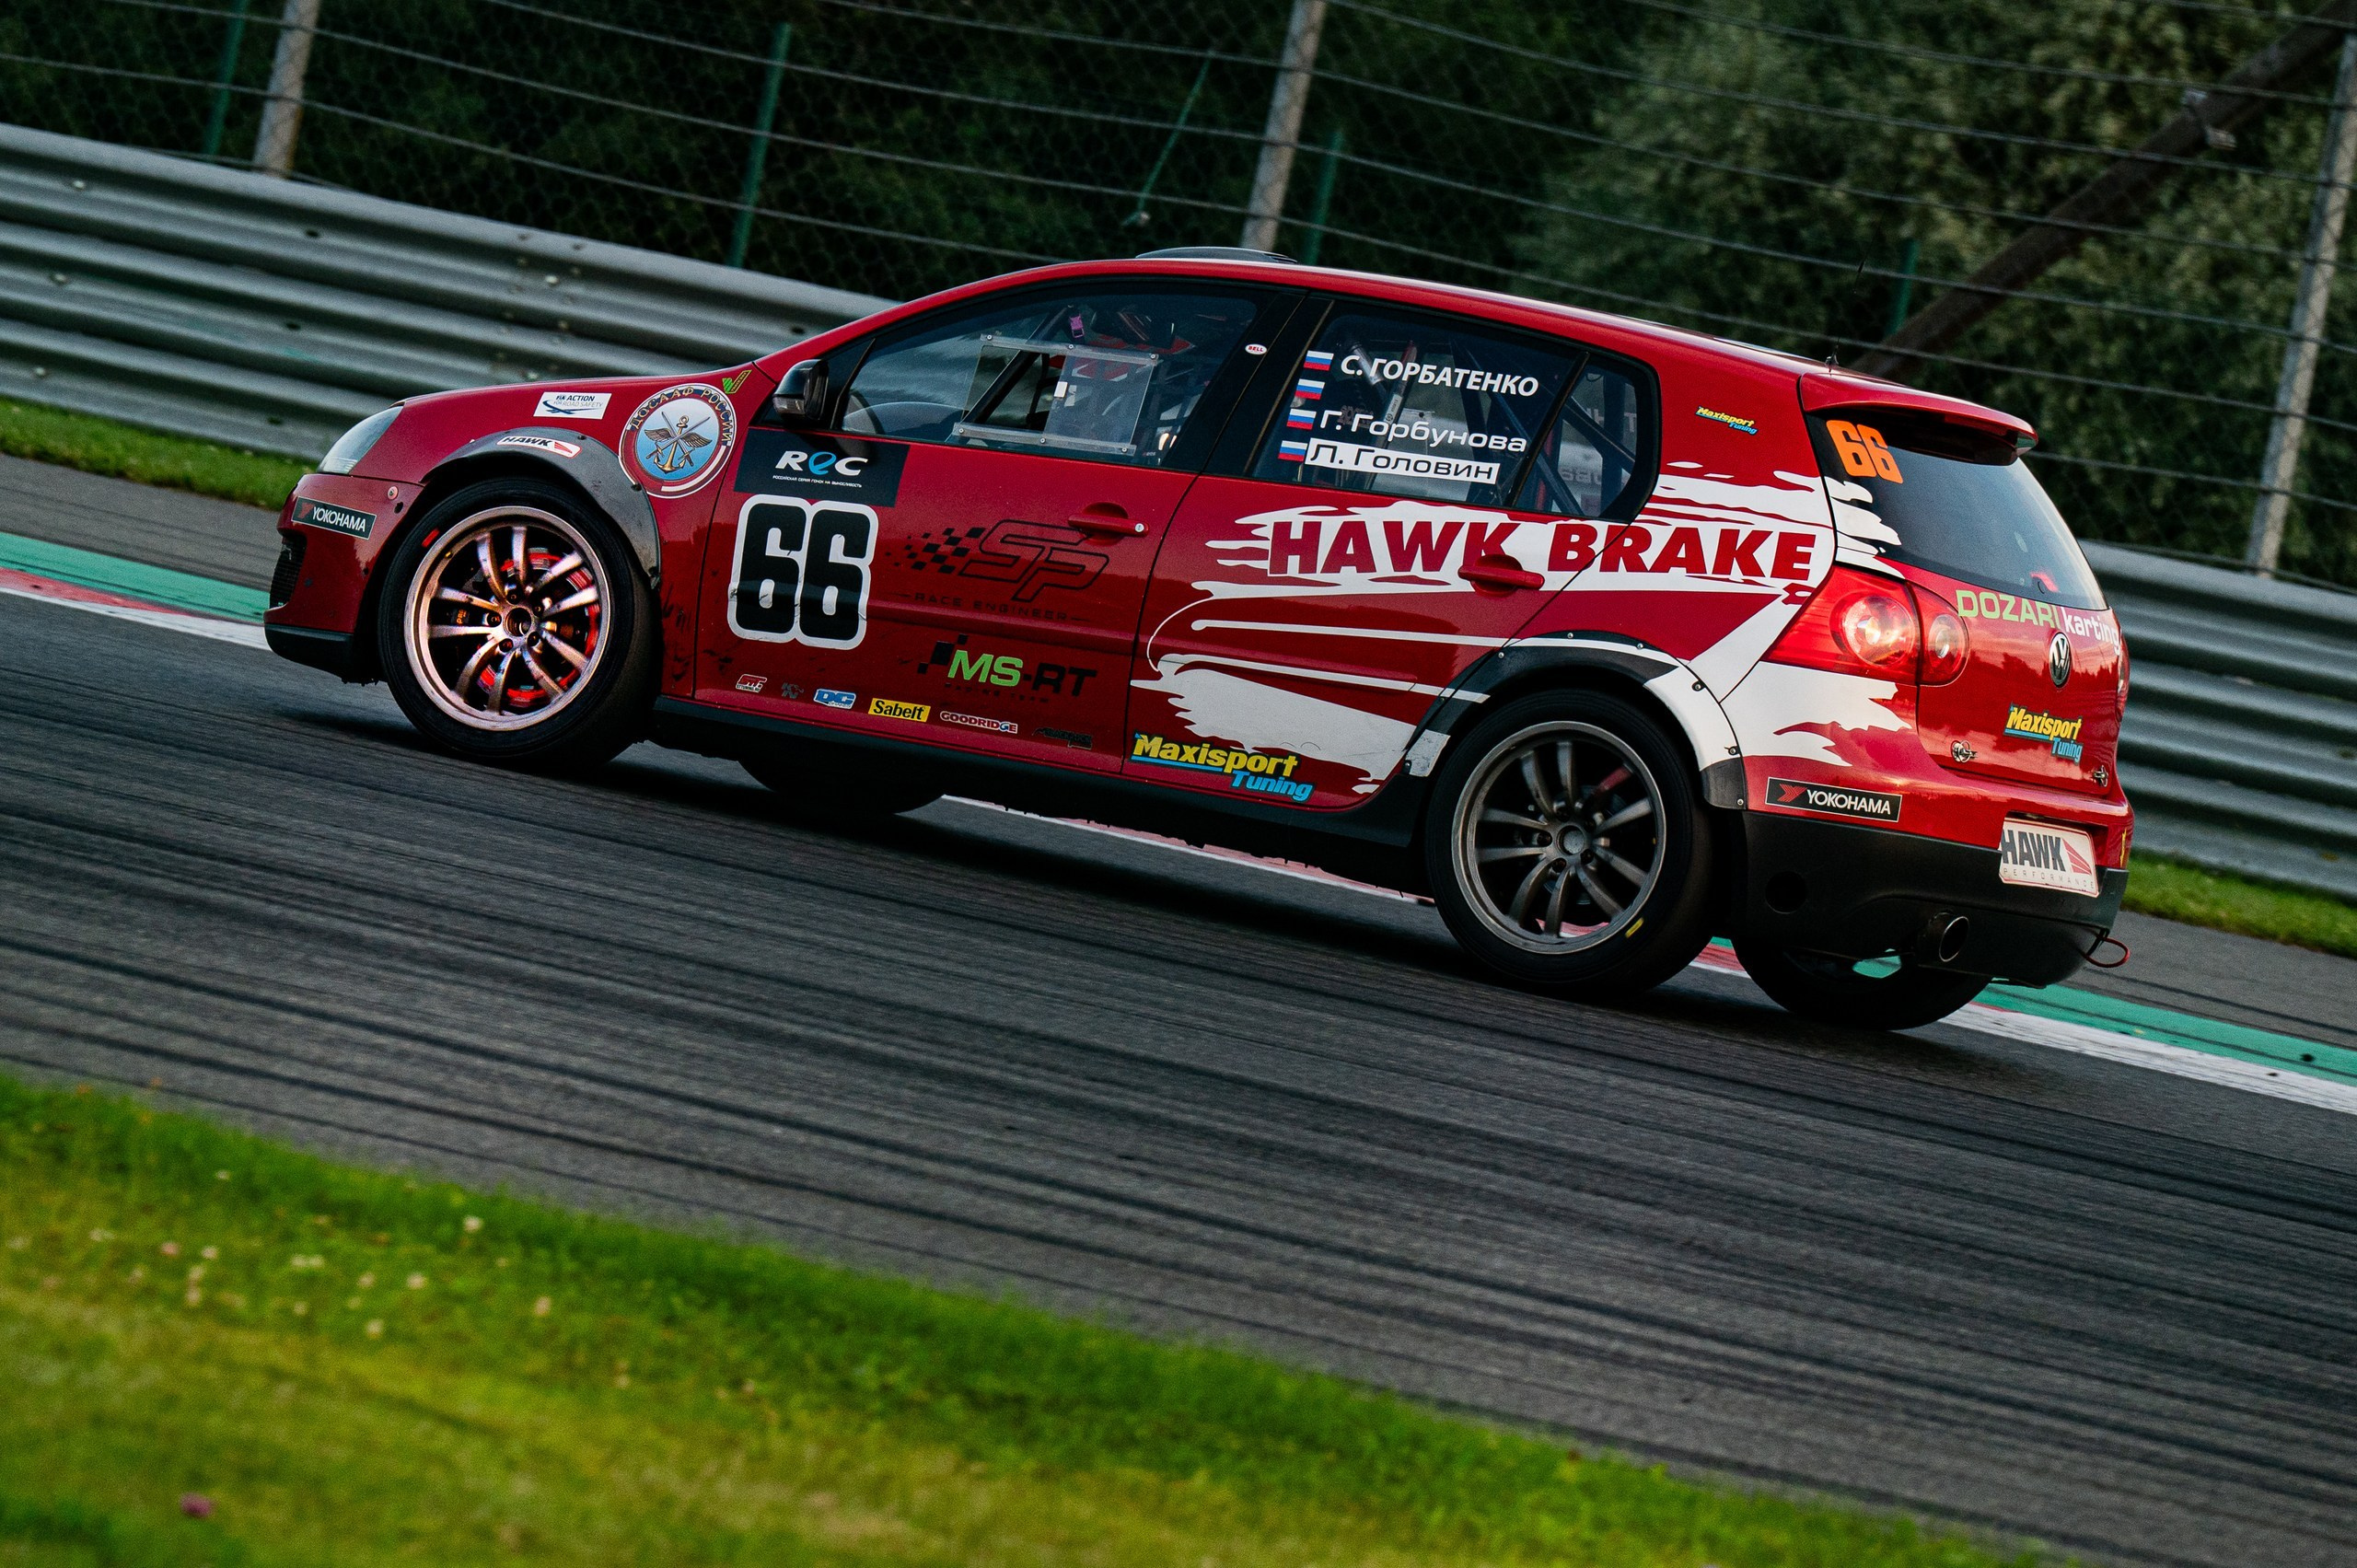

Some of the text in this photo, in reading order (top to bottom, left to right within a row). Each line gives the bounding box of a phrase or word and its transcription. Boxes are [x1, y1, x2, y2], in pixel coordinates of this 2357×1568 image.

[1341, 355, 1538, 397] С. ГОРБАТЕНКО
[630, 387, 732, 441] ДОСААФ РОССИИ
[1697, 407, 1755, 426] Maxisport
[1729, 422, 1758, 435] Tuning
[503, 437, 552, 447] HAWK
[1320, 410, 1342, 431] Г.
[1351, 413, 1527, 452] Горбунова
[1354, 447, 1493, 480] Головин
[1826, 420, 1903, 484] 66
[313, 506, 366, 532] YOKOHAMA
[1268, 520, 1817, 581] HAWK BRAKE
[736, 503, 870, 641] 66
[914, 593, 1067, 620] RACE ENGINEER
[1956, 589, 2120, 656] DOZARI karting
[873, 700, 924, 720] Sabelt
[940, 711, 1017, 734] GOODRIDGE
[2006, 706, 2082, 740] Maxisport
[1132, 734, 1298, 776] Maxisport
[2051, 738, 2083, 762] Tuning
[1231, 770, 1313, 802] Tuning
[1806, 789, 1890, 815] YOKOHAMA
[2000, 829, 2066, 872] HAWK
